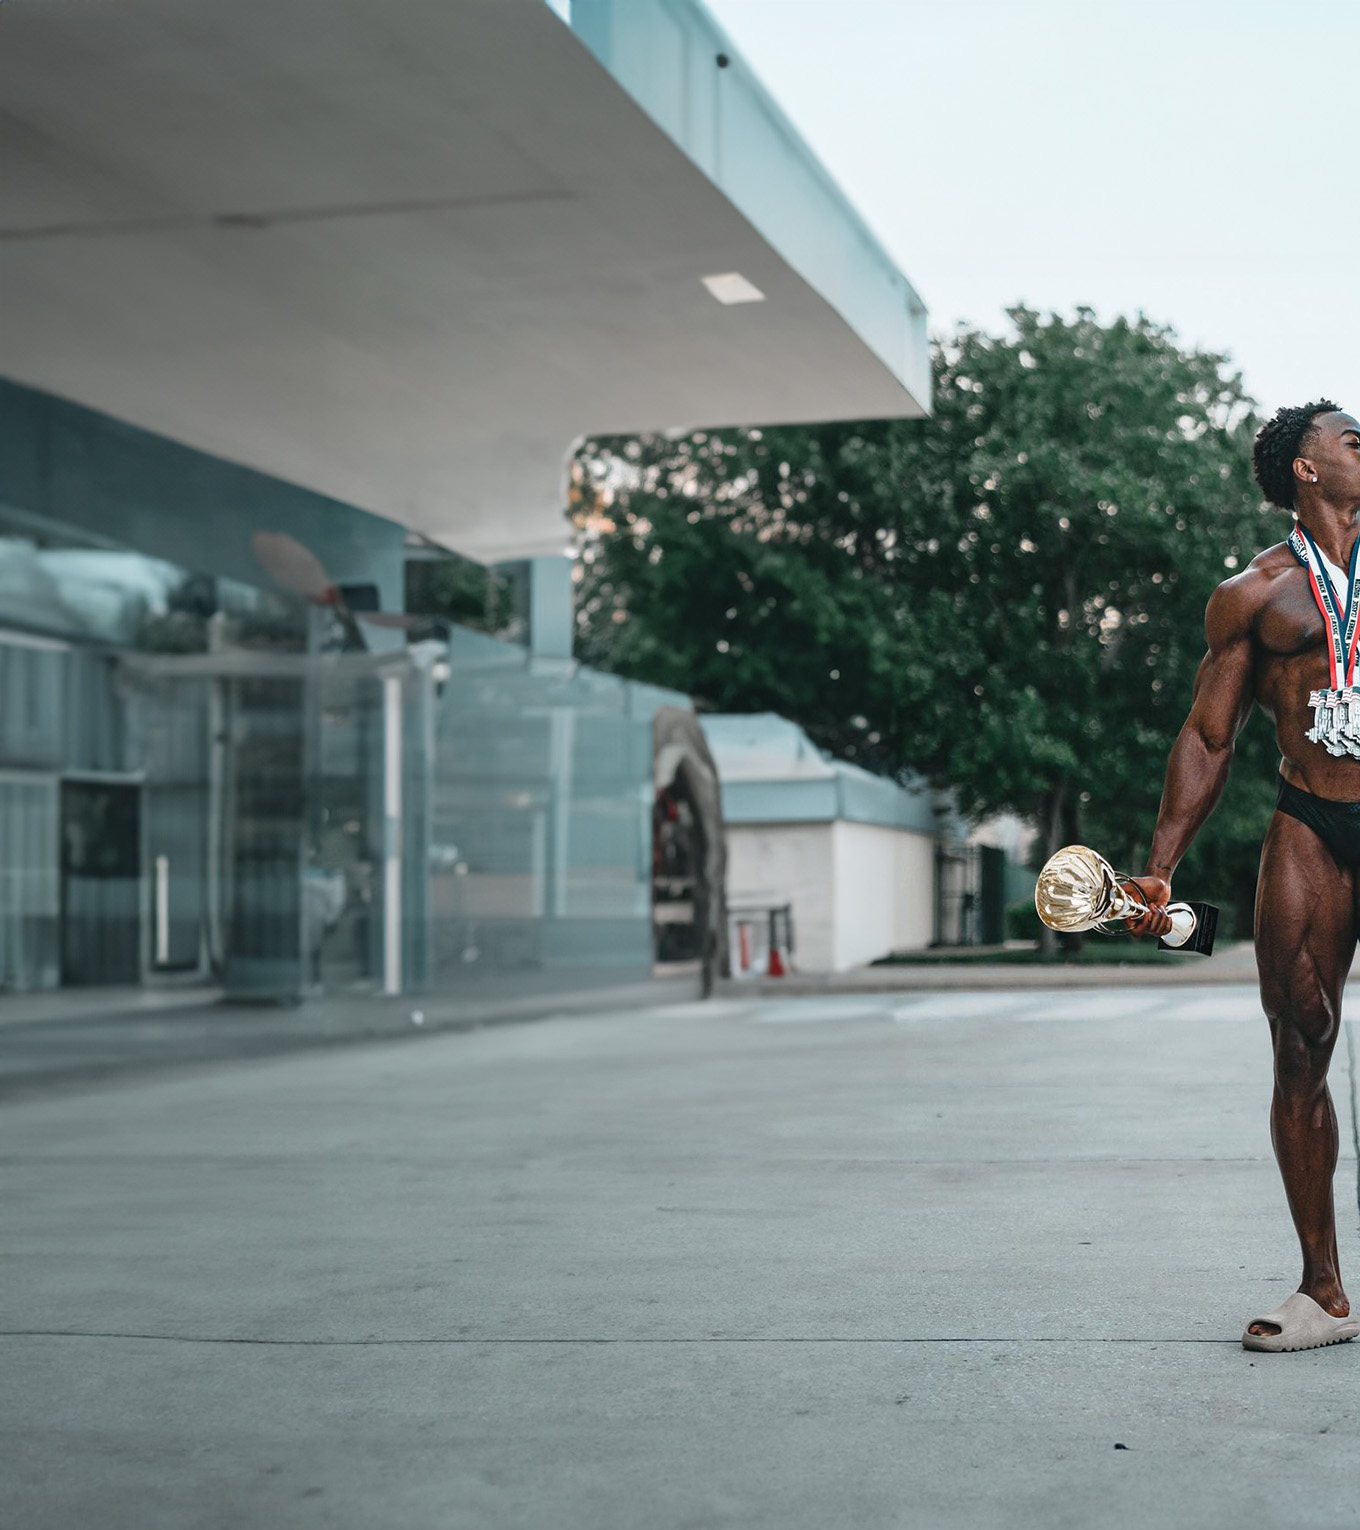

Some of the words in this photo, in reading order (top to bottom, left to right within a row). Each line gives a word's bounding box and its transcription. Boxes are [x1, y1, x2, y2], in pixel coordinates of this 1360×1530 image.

[1316, 574, 1326, 593] BRANCH
[1322, 594, 1334, 614] WARREN
[1351, 599, 1359, 618] CLASSIC
[1330, 615, 1339, 636] CLASSIC
[1334, 638, 1342, 663] HOUSTON
